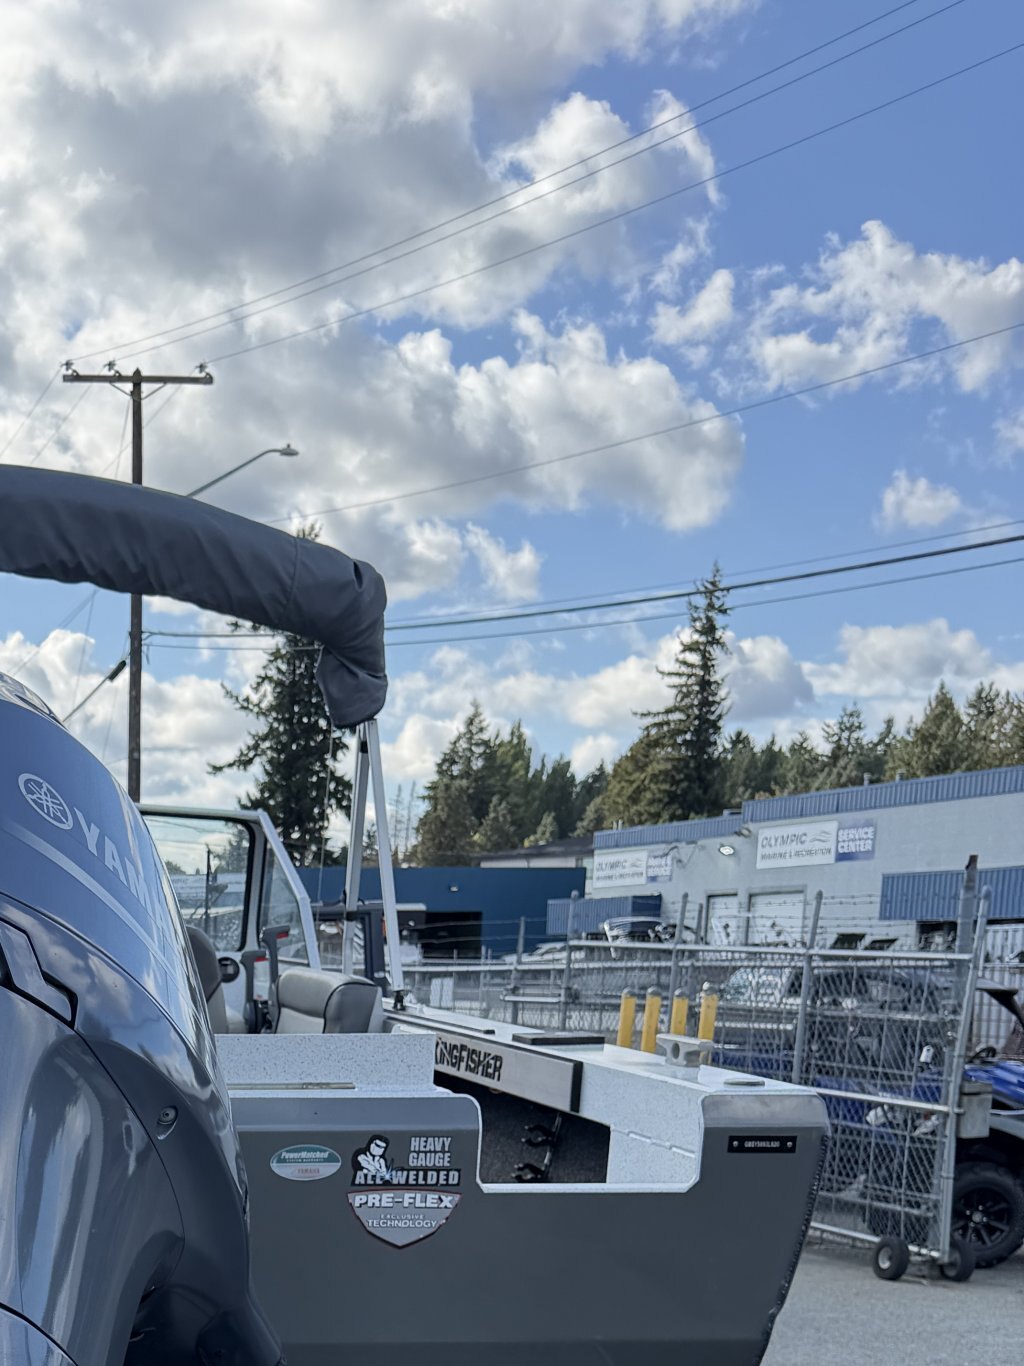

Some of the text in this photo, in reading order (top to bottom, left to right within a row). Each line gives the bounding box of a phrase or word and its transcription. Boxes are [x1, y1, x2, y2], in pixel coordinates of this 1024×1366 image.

[760, 832, 807, 848] OLYMPIC
[838, 826, 874, 842] SERVICE
[838, 840, 873, 854] CENTER
[410, 1137, 451, 1151] HEAVY
[281, 1151, 329, 1159] PowerMatched
[409, 1152, 451, 1167] GAUGE
[355, 1171, 458, 1185] ALL WELDED
[354, 1193, 453, 1208] PRE-FLEX
[367, 1219, 437, 1228] TECHNOLOGY
